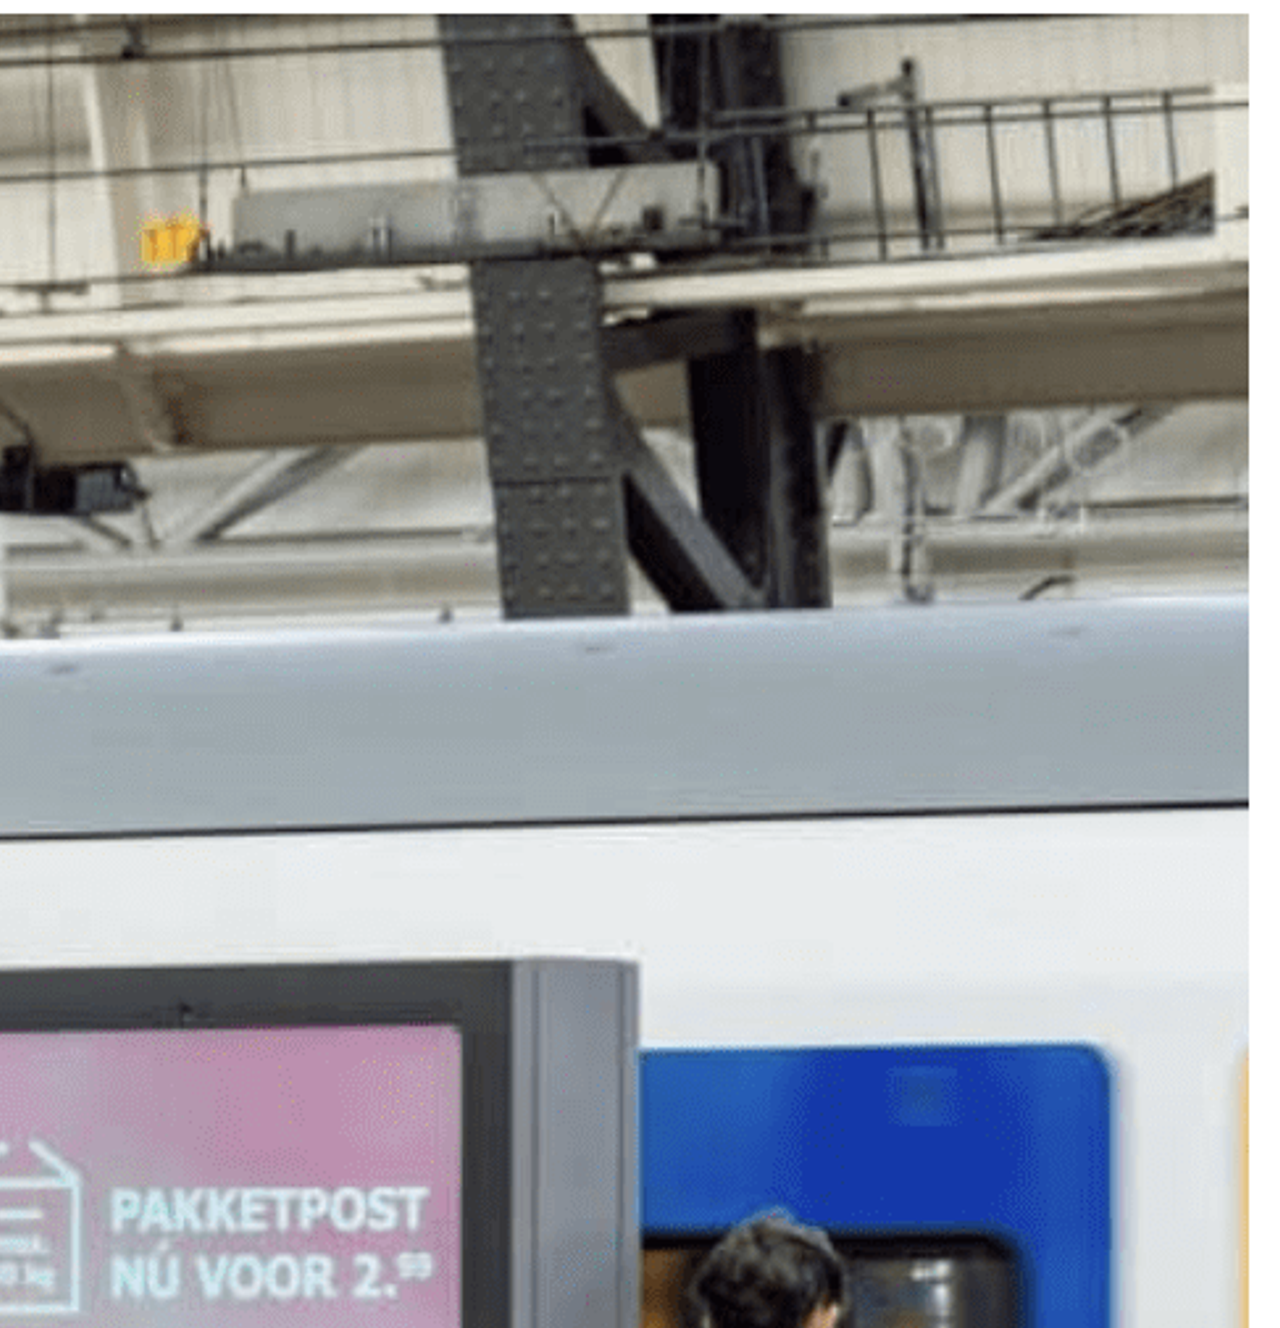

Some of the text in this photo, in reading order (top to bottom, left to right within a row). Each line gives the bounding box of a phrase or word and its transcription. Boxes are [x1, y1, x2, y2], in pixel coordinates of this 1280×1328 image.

[111, 1186, 430, 1232] PAKKETPOST
[111, 1239, 180, 1299] NÚ
[195, 1254, 338, 1299] VOOR
